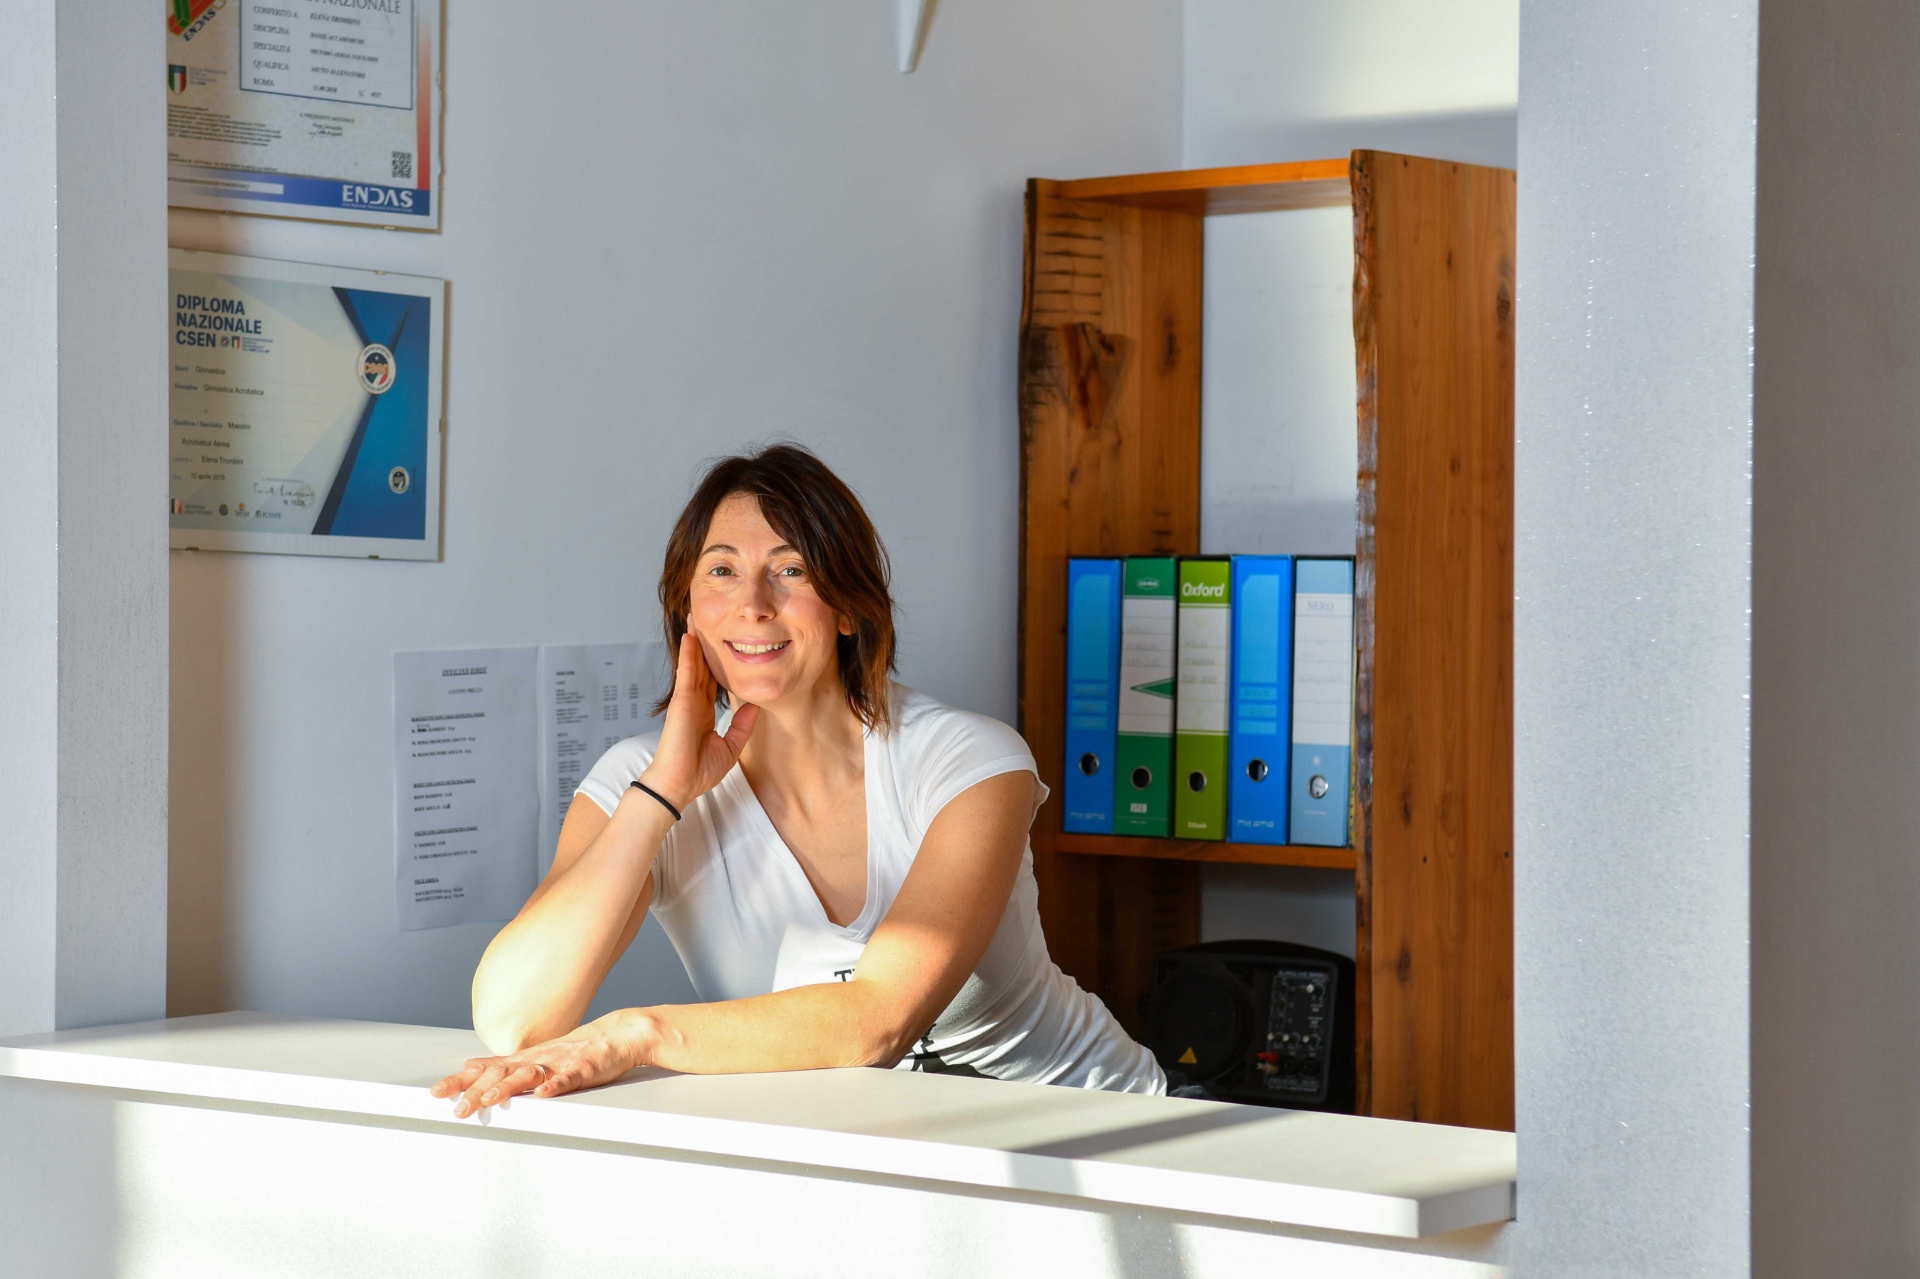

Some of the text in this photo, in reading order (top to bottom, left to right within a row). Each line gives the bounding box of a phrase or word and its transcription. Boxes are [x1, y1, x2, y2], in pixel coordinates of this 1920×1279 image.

[183, 8, 216, 41] ENDAS
[342, 185, 414, 208] ENDAS
[177, 294, 245, 315] DIPLOMA
[176, 312, 262, 334] NAZIONALE
[176, 330, 216, 348] CSEN
[195, 366, 225, 376] Ginnastica
[203, 384, 234, 394] Ginnastica
[235, 387, 265, 396] Acrobatica
[182, 438, 212, 447] Acrobatica
[201, 456, 218, 464] Elena
[219, 457, 244, 465] Trombini
[1182, 582, 1225, 598] Oxford
